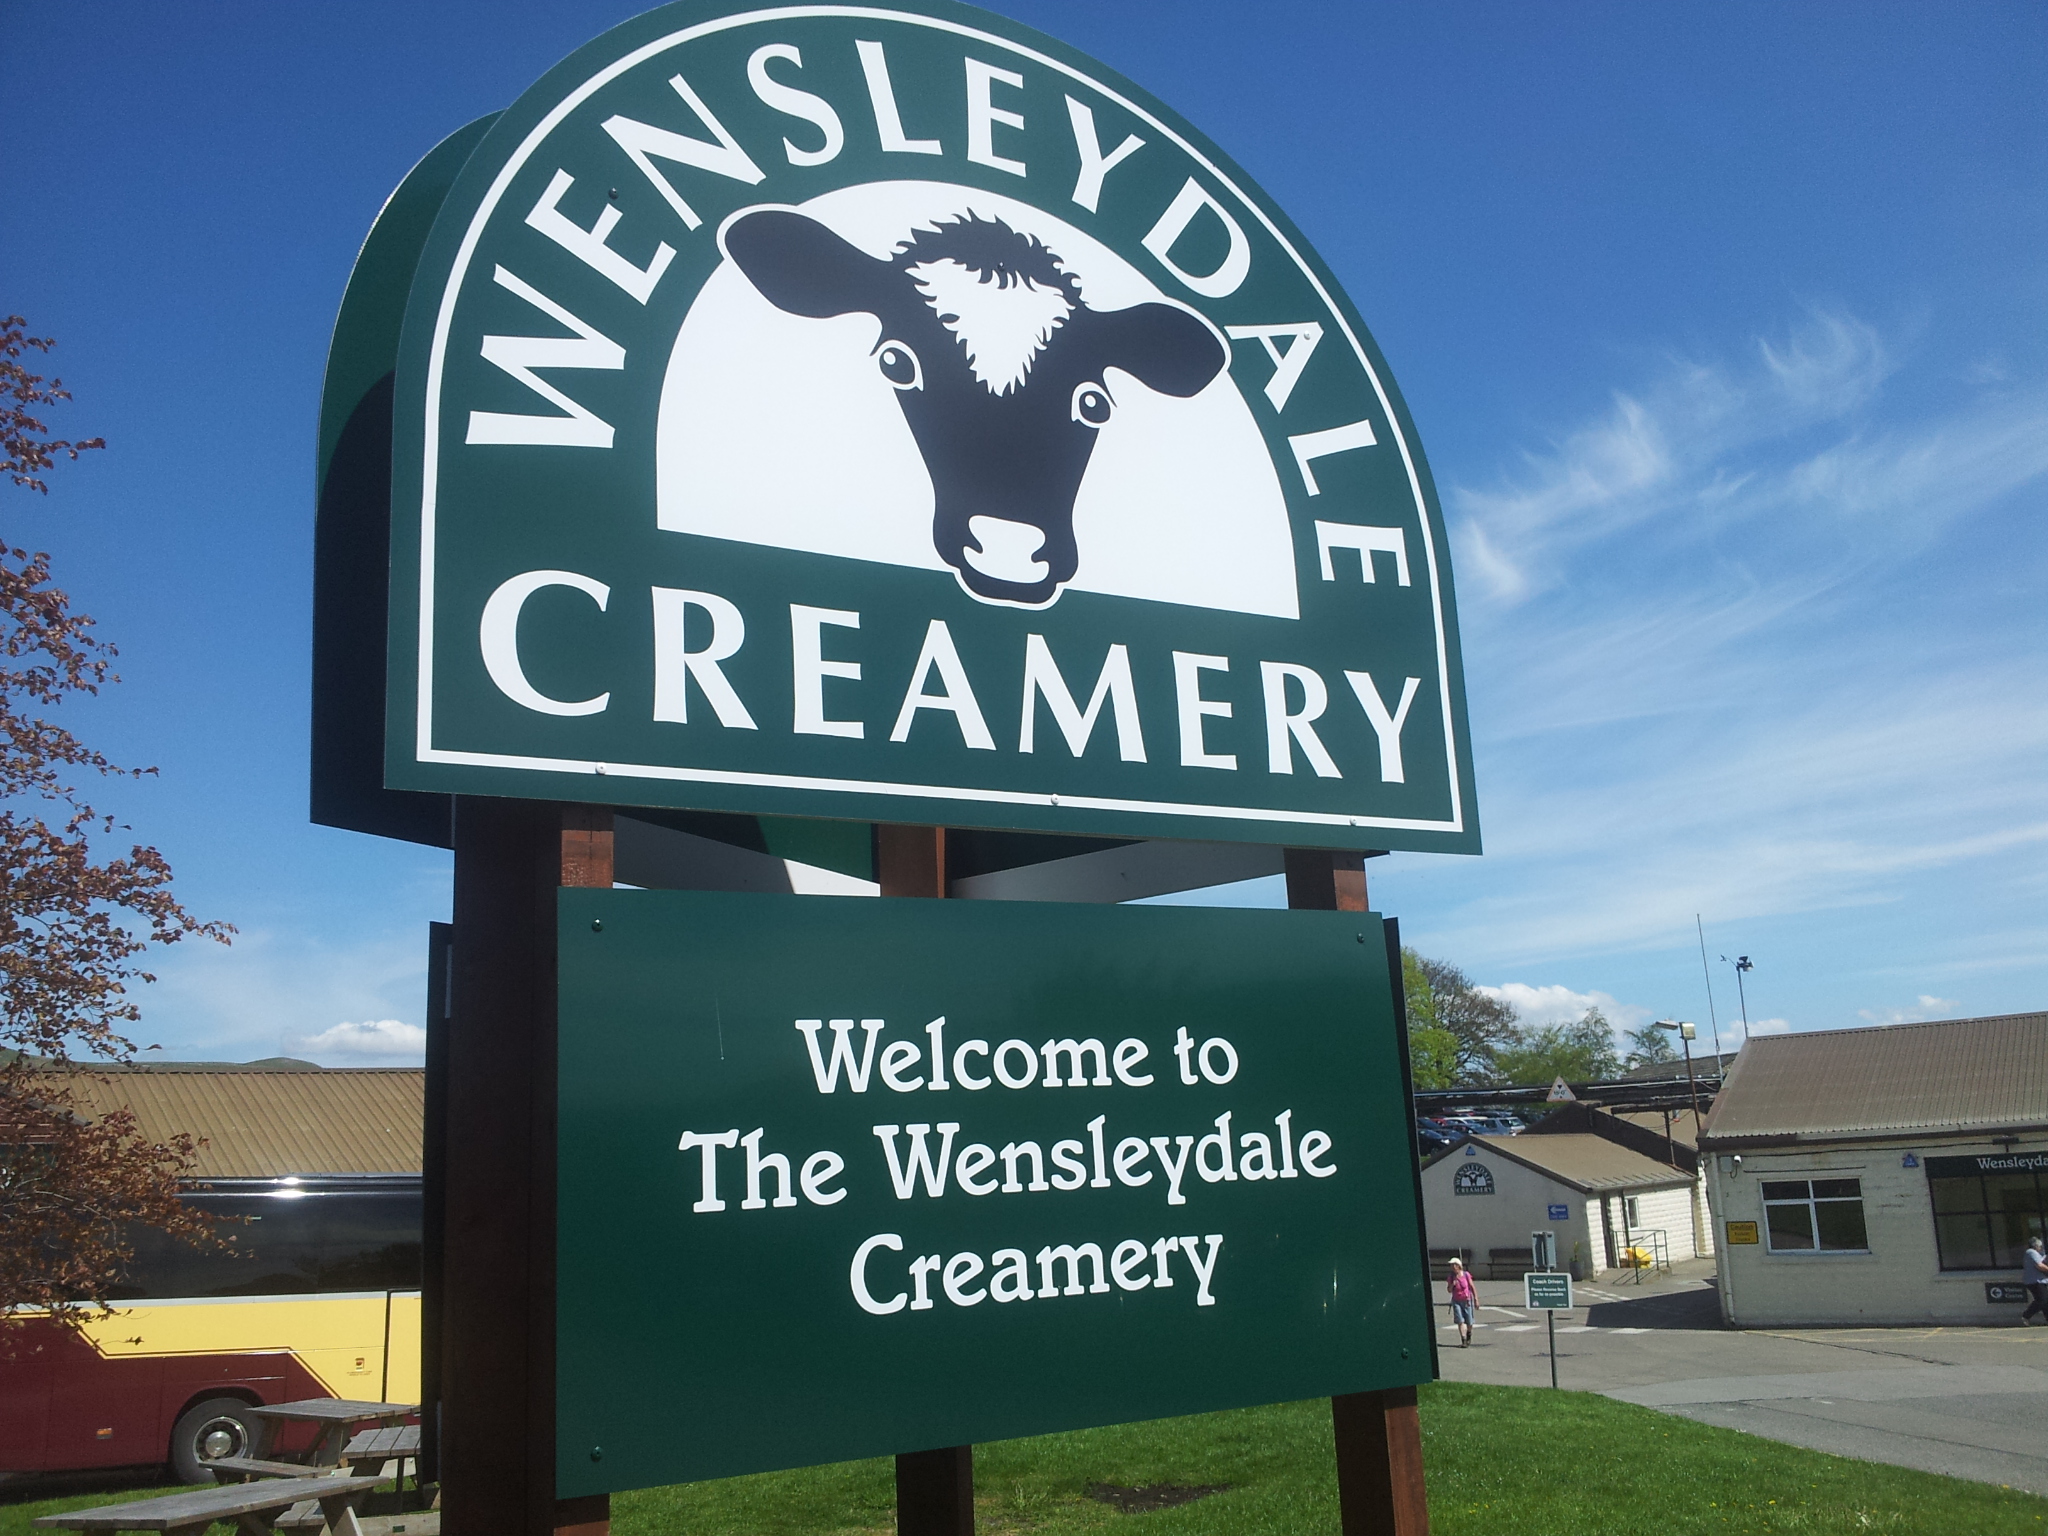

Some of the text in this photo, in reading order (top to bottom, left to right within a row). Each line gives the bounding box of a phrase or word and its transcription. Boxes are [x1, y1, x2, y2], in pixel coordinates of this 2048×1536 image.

[465, 39, 1410, 589] WENSLEYDALE
[480, 569, 1421, 785] CREAMERY
[795, 1016, 1239, 1093] Welcome to
[678, 1108, 1338, 1213] The Wensleydale
[850, 1232, 1223, 1315] Creamery
